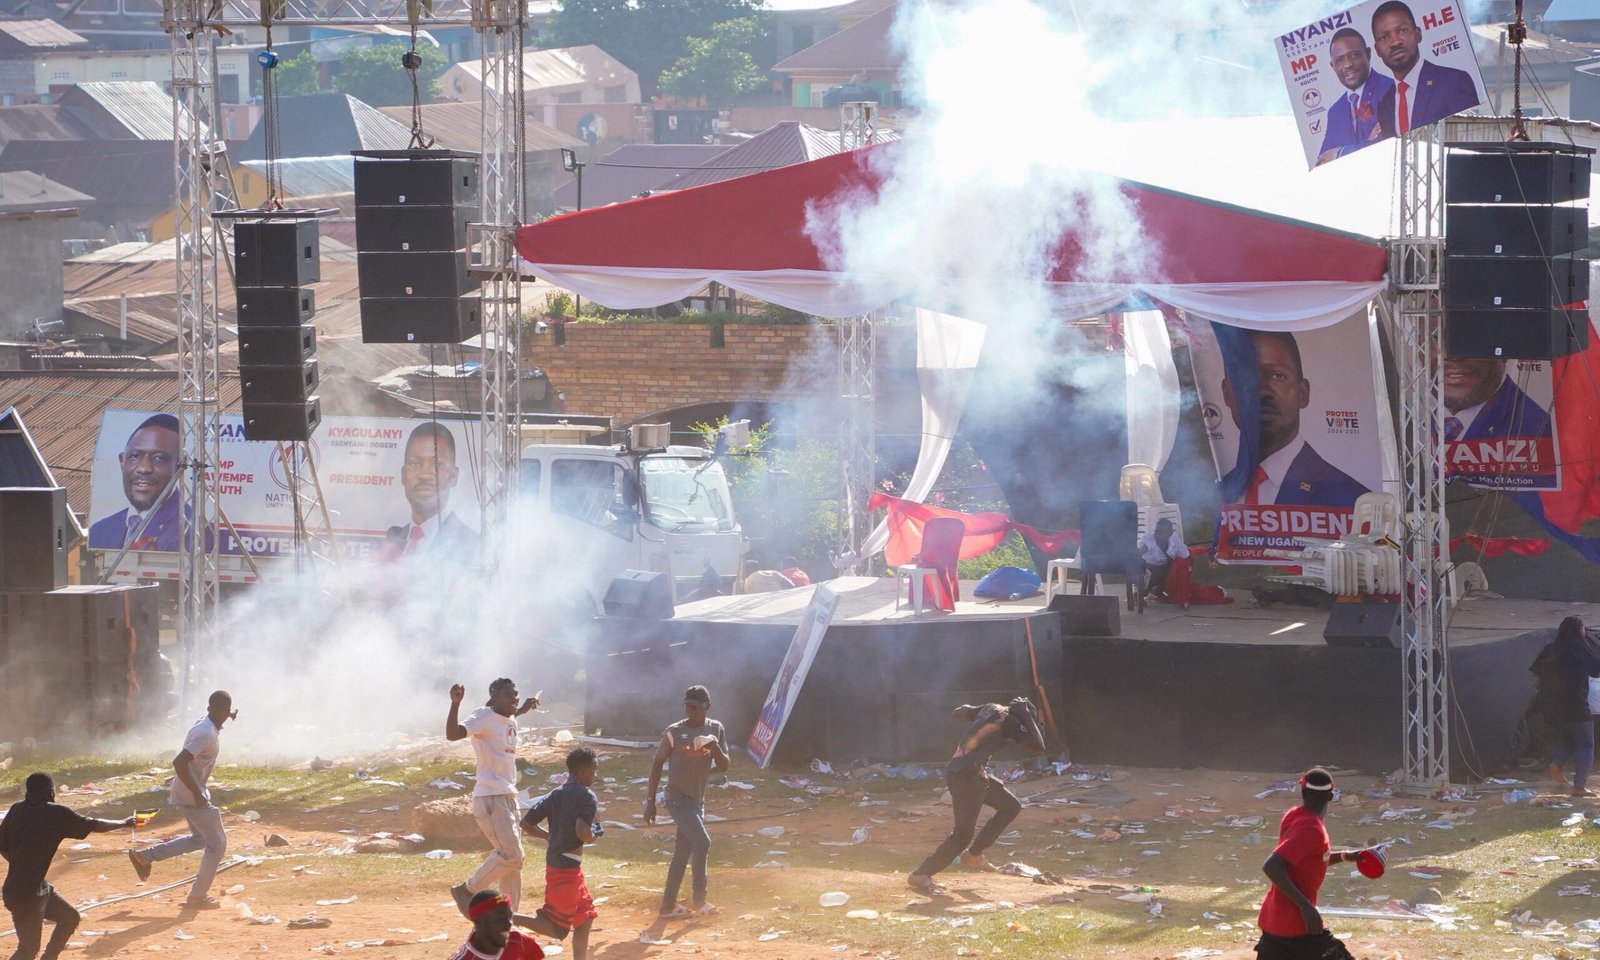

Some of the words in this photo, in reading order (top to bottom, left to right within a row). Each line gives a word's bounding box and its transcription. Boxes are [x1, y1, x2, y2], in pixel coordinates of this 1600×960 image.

[1422, 6, 1455, 30] H.E
[1280, 11, 1352, 48] NYANZI
[1432, 35, 1457, 48] PROTEST
[1432, 40, 1460, 57] VOTE
[1290, 54, 1317, 75] MP
[1294, 69, 1320, 82] KAWEMPE
[1300, 77, 1318, 86] SOUTH
[1325, 417, 1359, 428] VOTE
[328, 427, 403, 439] KYAGULANYI
[204, 471, 254, 483] AWEMPE
[329, 474, 395, 486] PRESIDENT
[1238, 536, 1265, 546] NEW
[1267, 537, 1310, 547] UGAN
[1233, 549, 1262, 557] PEOPLE
